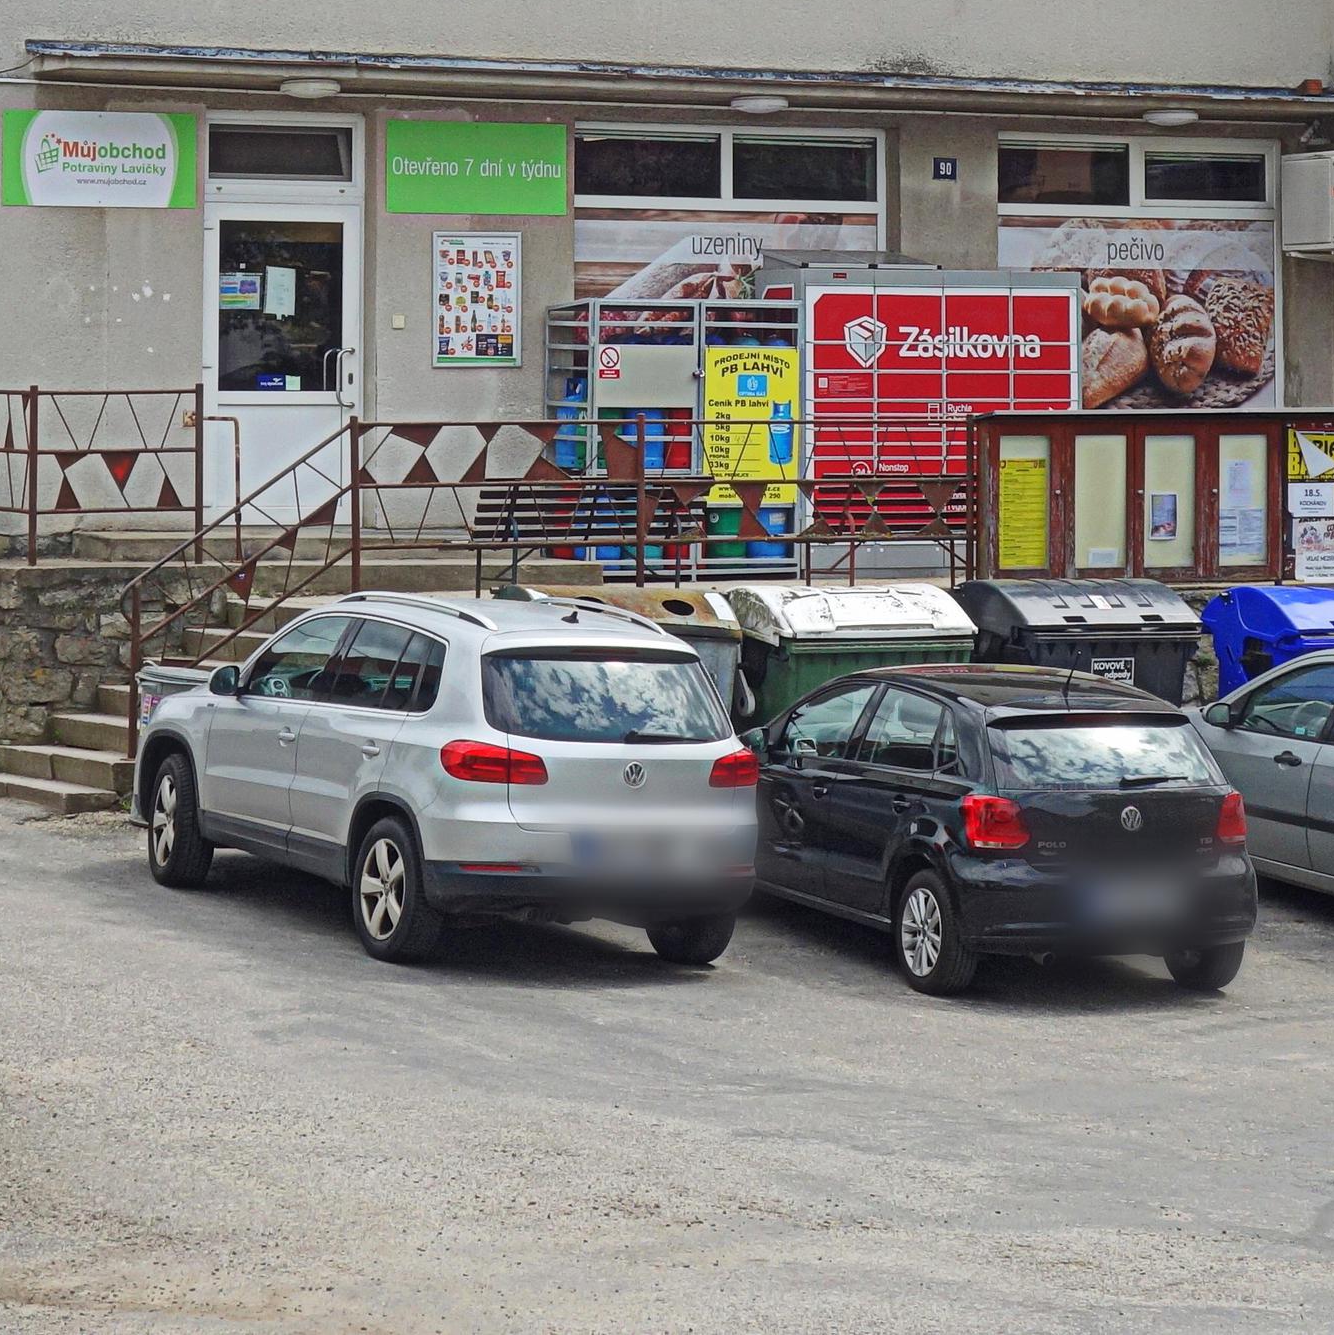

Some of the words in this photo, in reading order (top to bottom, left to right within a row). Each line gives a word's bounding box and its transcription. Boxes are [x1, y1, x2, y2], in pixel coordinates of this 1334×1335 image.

[62, 140, 166, 162] Můjobchod
[62, 162, 118, 175] Potraviny
[121, 163, 167, 176] Lavičky
[392, 156, 459, 176] Otevřeno
[464, 158, 474, 176] 7
[480, 158, 502, 177] dní
[507, 162, 516, 177] v
[521, 158, 561, 181] týdnu
[939, 161, 952, 175] 90
[692, 232, 764, 261] uzeniny
[1107, 236, 1165, 265] pečivo
[898, 325, 1041, 358] Zásilkovna
[721, 363, 739, 378] PB
[743, 361, 783, 378] LAHVÍ
[735, 399, 747, 407] PB
[715, 411, 731, 420] 2kg
[710, 434, 731, 444] 10kg
[710, 446, 730, 455] 10kg
[878, 463, 909, 473] Nonstop
[1304, 488, 1323, 497] 18.5.
[1093, 660, 1125, 670] KOVOVÉ
[1037, 841, 1067, 849] POLO
